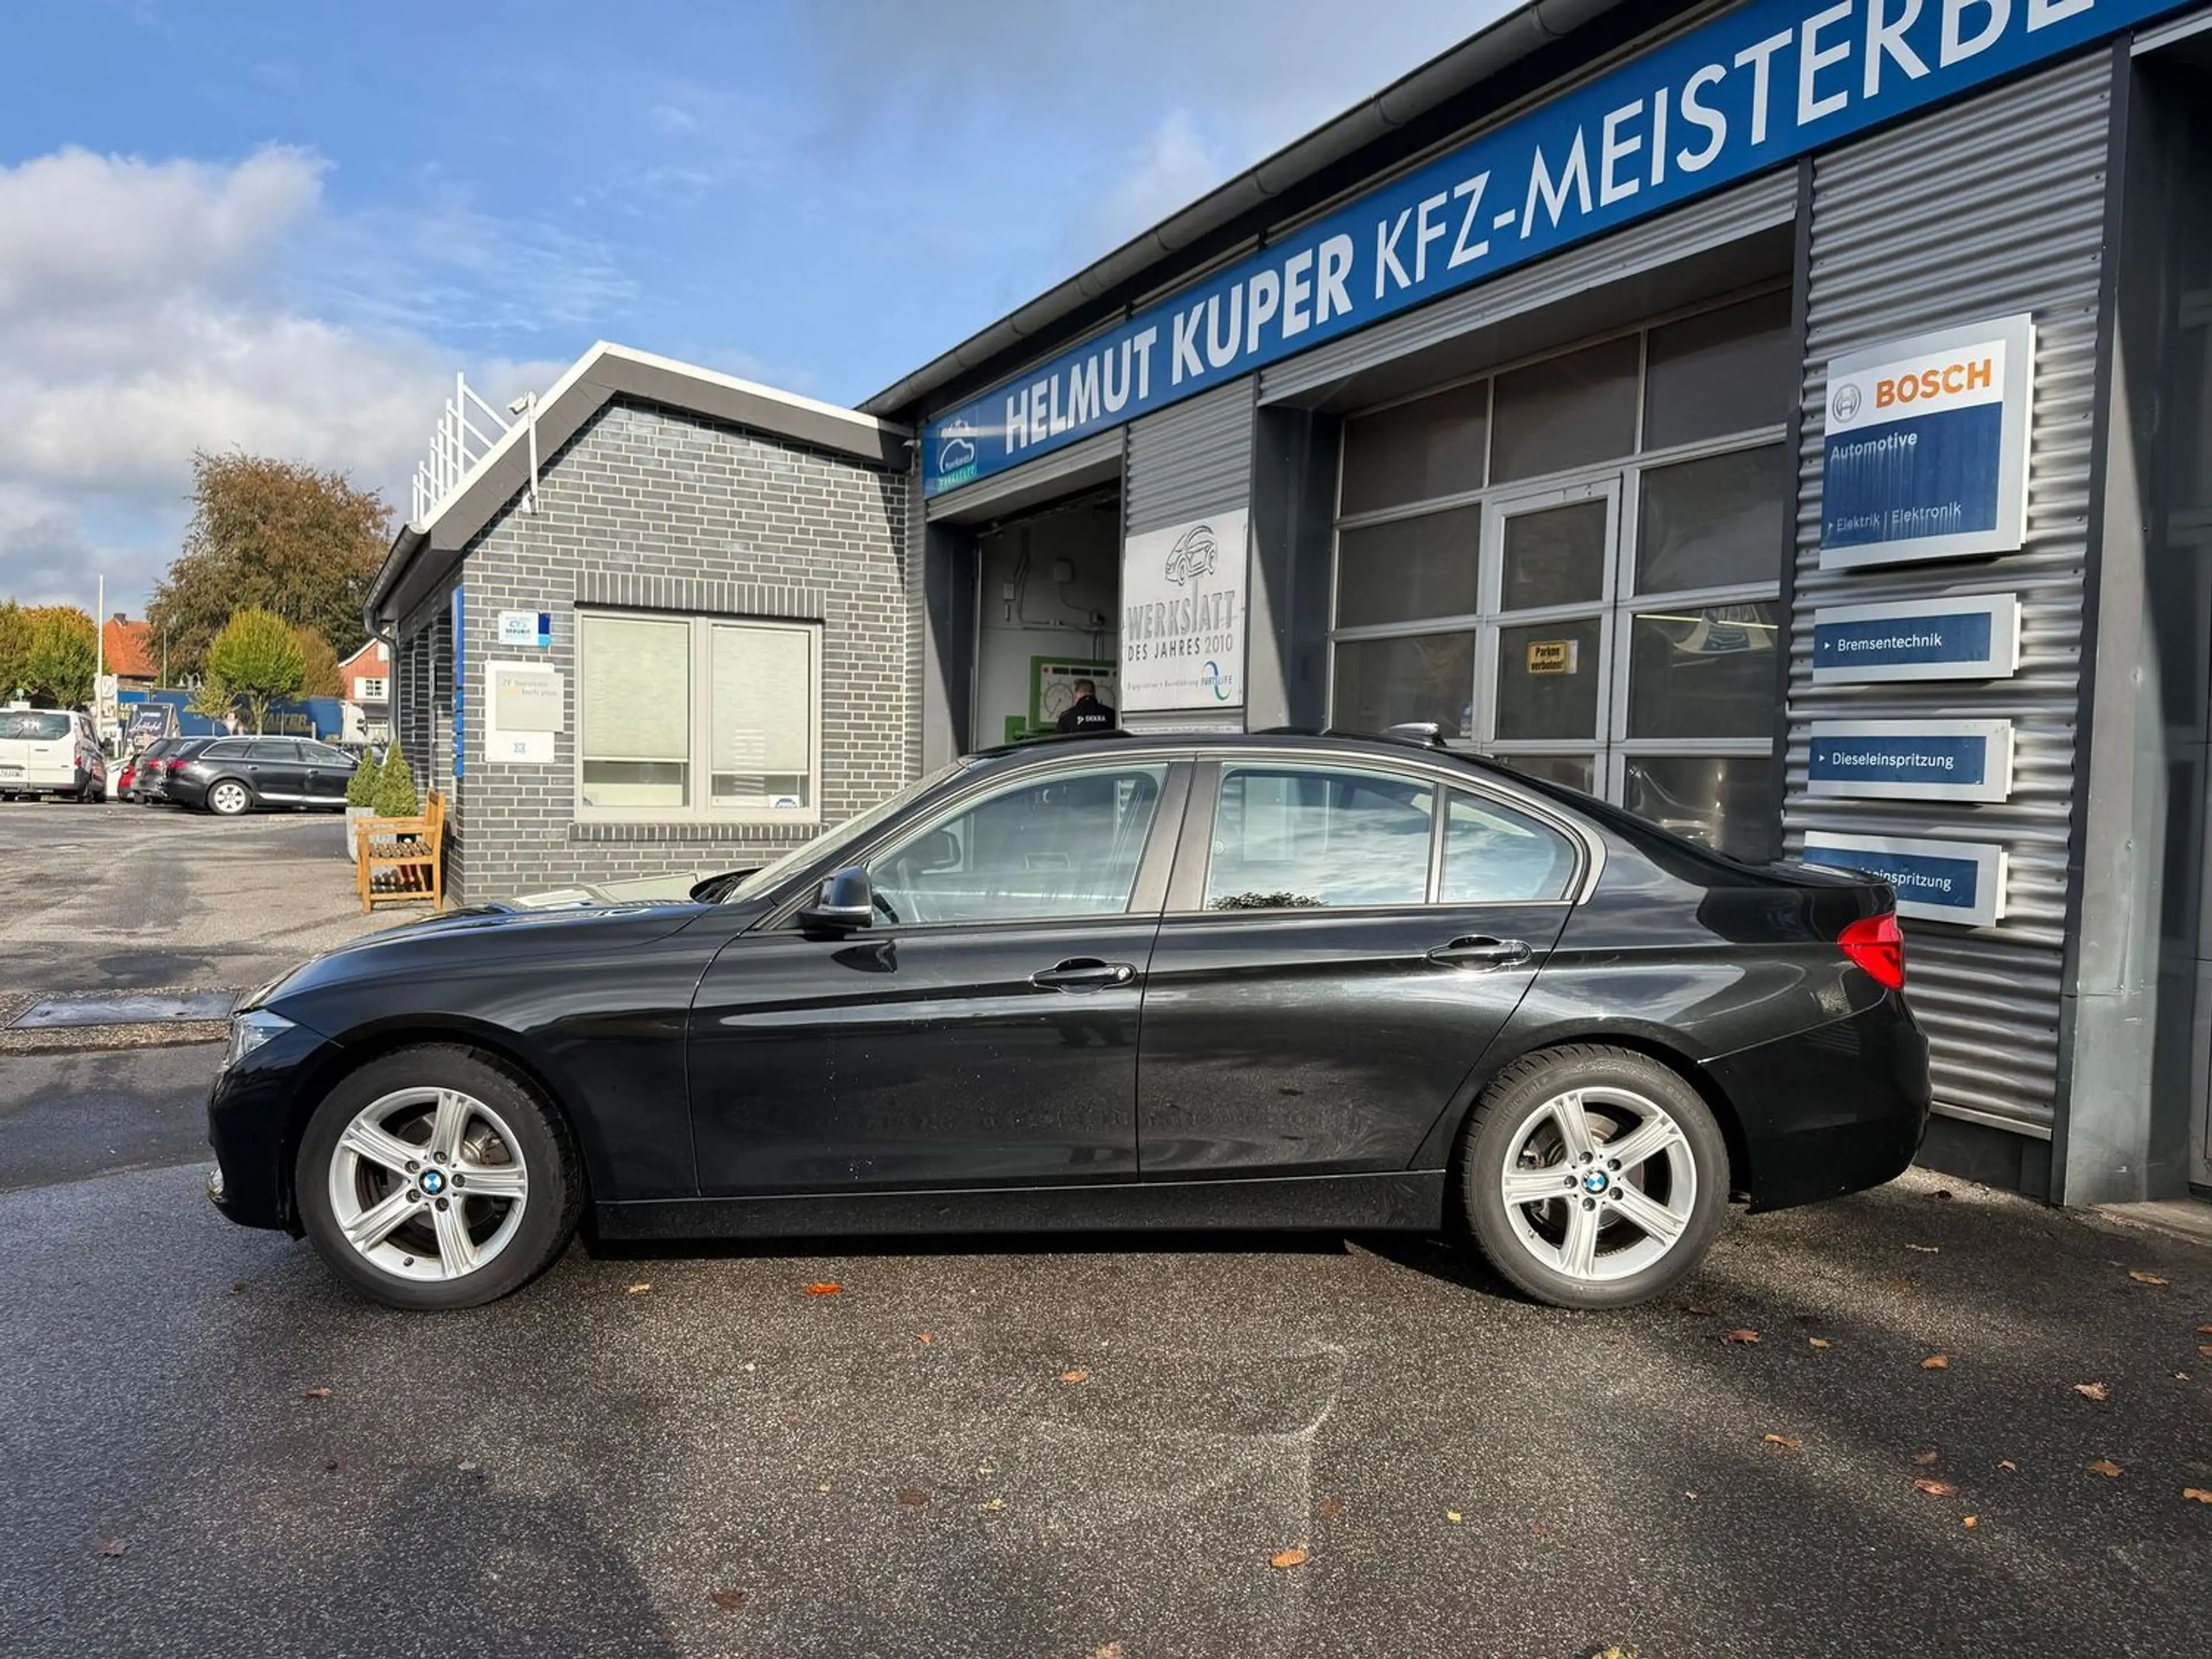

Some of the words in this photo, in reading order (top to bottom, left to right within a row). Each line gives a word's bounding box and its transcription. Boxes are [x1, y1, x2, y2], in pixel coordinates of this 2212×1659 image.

[1005, 326, 1157, 454] HELMUT
[1171, 234, 1354, 385] KUPER
[1375, 0, 2095, 299] KFZ-MEISTERB
[1876, 358, 1991, 409] BOSCH
[1830, 432, 1918, 461] Automotive
[1836, 512, 1881, 532] Elektrik
[1892, 501, 1961, 523] Elektronik
[1127, 588, 1236, 641] WERKSTATT
[1128, 643, 1148, 661] DES
[1154, 637, 1200, 659] JAHRES
[1205, 634, 1233, 654] 2010
[1837, 632, 1942, 652] Bremsentechnik
[1832, 752, 1955, 770] Dieseleinspritzung
